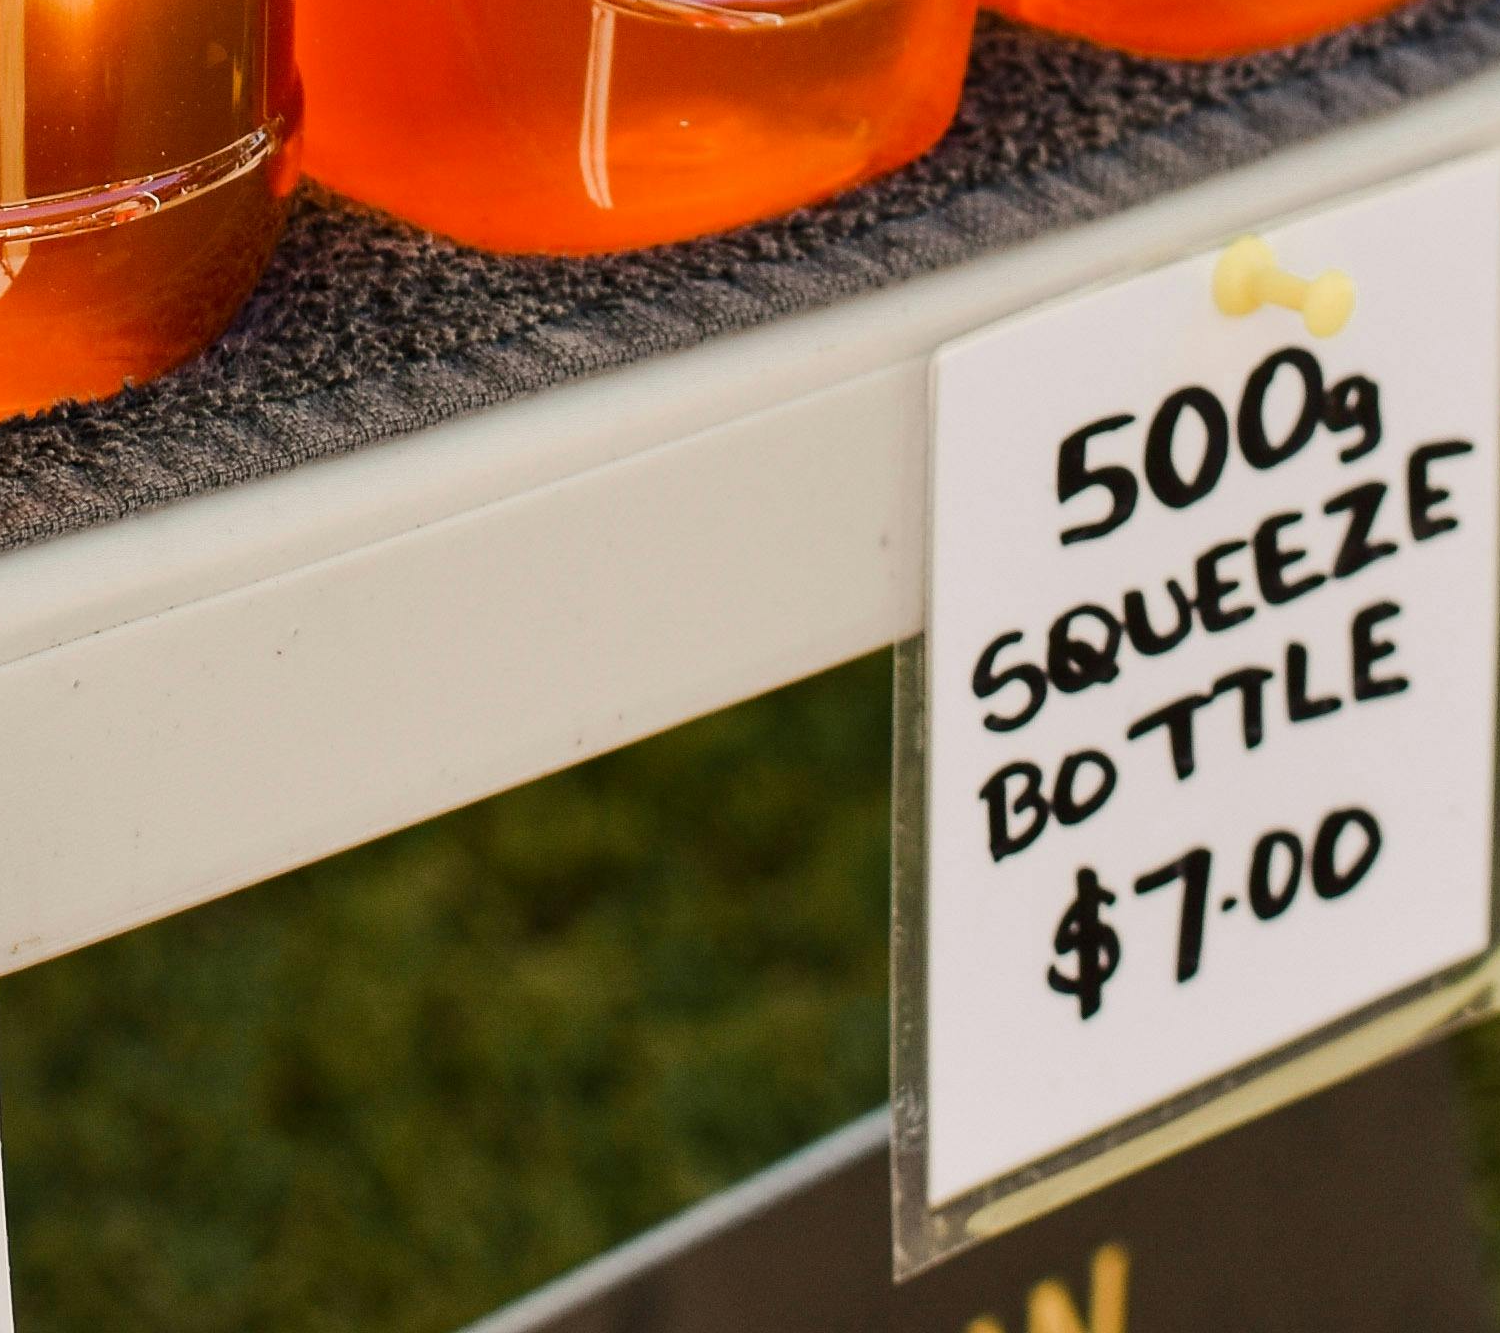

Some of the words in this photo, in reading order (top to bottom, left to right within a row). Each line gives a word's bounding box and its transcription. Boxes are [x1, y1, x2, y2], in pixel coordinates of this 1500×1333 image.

[1055, 346, 1384, 548] 500g
[970, 440, 1476, 733] SQUEEZE
[979, 600, 1410, 863] BOTTLE
[1046, 805, 1383, 1021] $7.00
